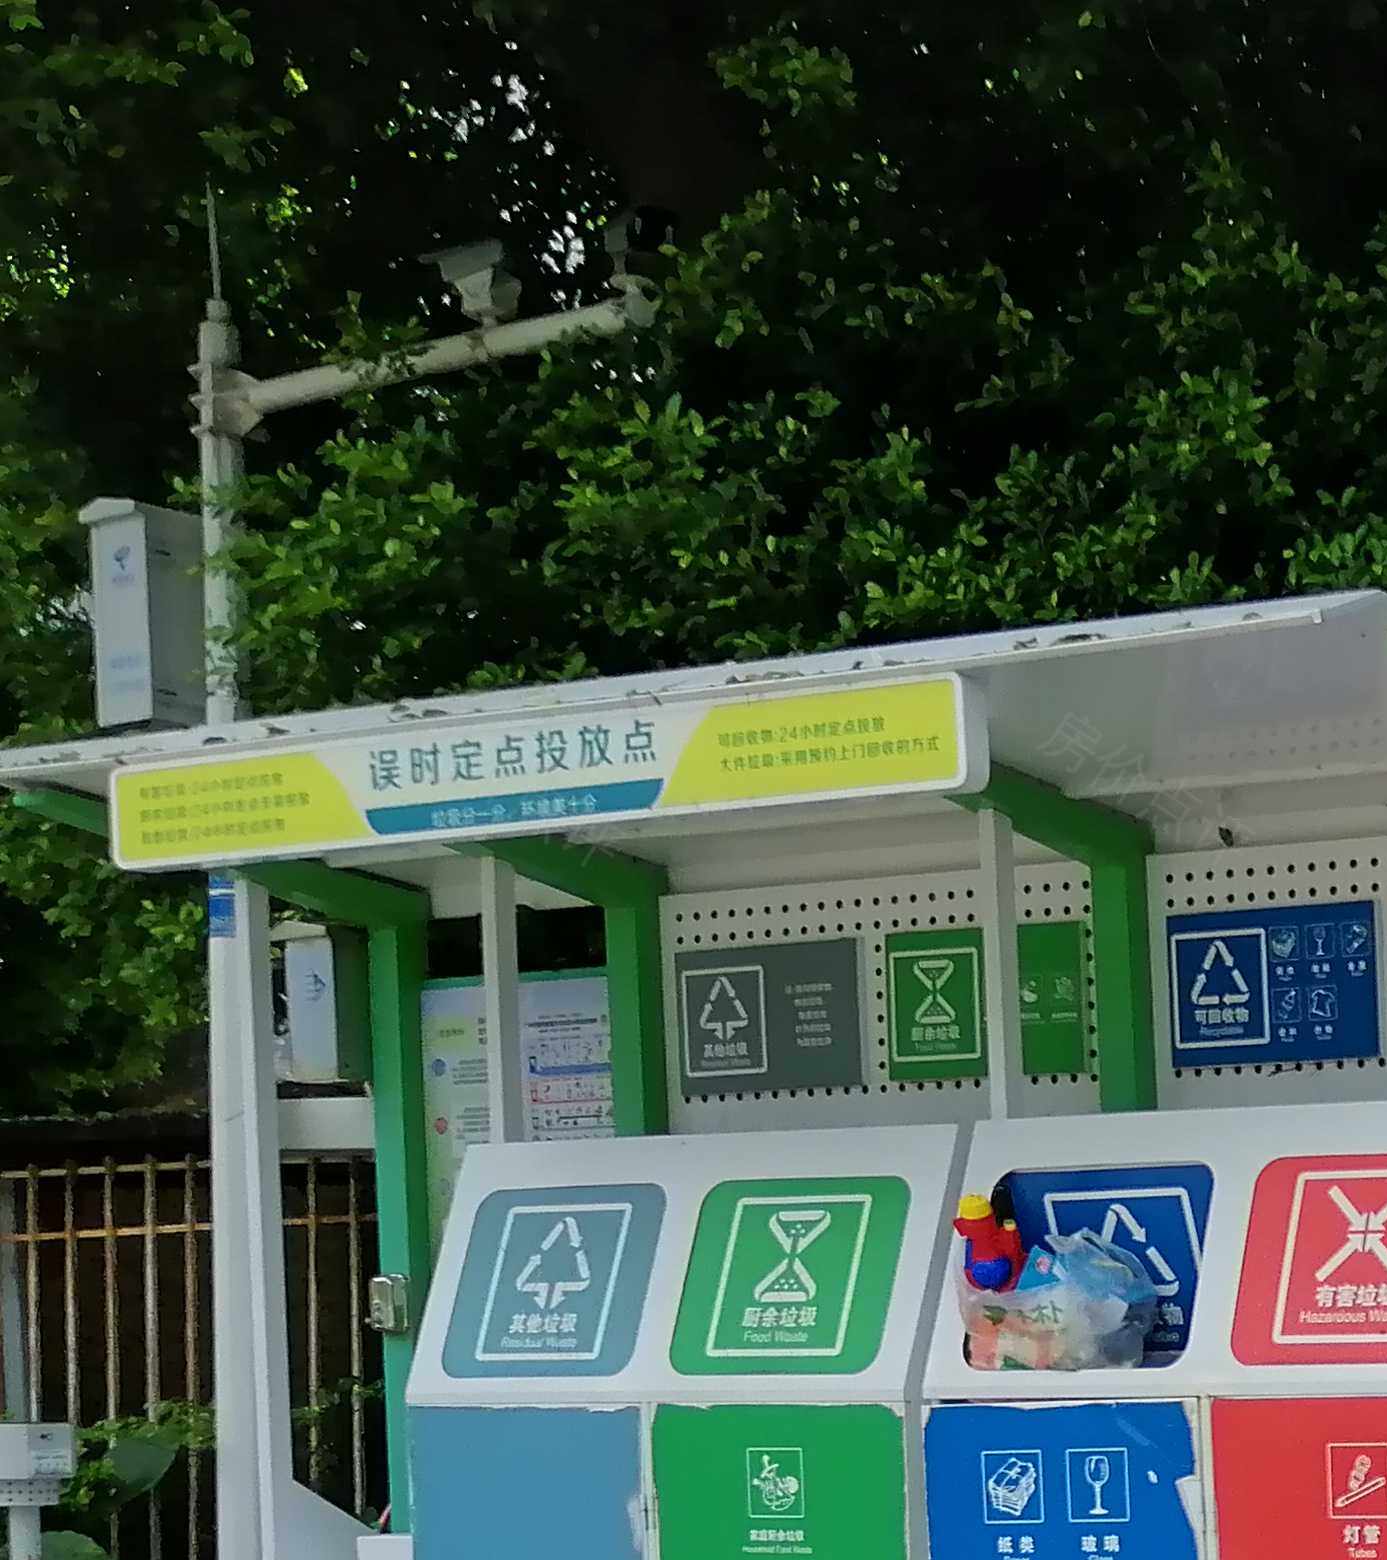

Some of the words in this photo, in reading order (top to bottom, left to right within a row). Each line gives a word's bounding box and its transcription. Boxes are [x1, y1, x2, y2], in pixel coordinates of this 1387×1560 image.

[369, 719, 656, 791] 误时定点投放点
[1194, 1006, 1249, 1025] 可回收物
[509, 1313, 577, 1333] 其他垃圾
[741, 1306, 817, 1328] 厨余垃圾
[1300, 1310, 1367, 1323] Hazardous
[743, 1331, 772, 1342] Food
[1081, 1534, 1120, 1553] 玻璃
[1343, 1524, 1381, 1545] 灯管
[998, 1536, 1034, 1554] 纸类
